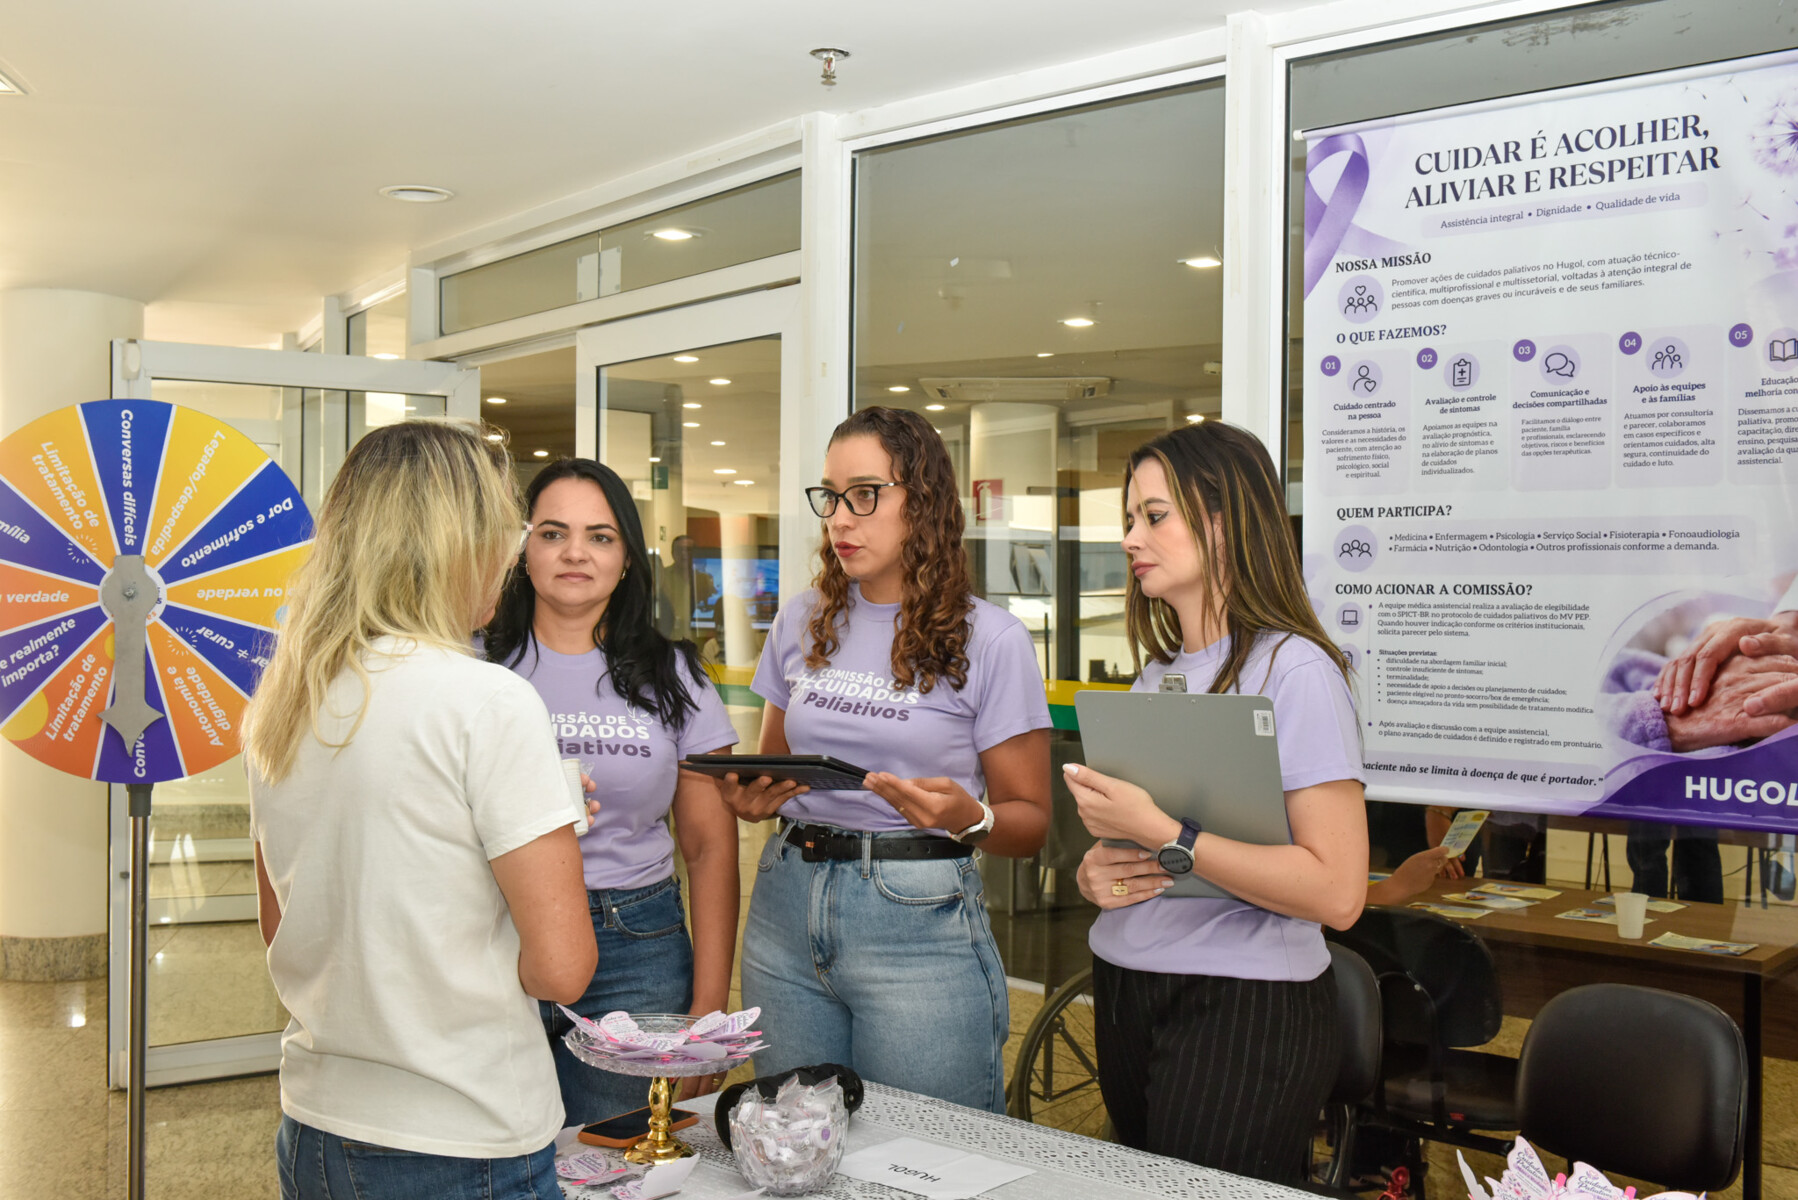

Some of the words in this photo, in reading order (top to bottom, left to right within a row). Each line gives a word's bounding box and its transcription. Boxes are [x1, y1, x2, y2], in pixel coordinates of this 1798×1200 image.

[1415, 141, 1522, 176] CUIDAR
[1531, 130, 1547, 159] É
[1554, 114, 1710, 158] ACOLHER,
[1404, 173, 1516, 208] ALIVIAR
[1525, 170, 1541, 193] E
[1549, 146, 1721, 190] RESPEITAR
[1440, 216, 1488, 228] Assistência
[1490, 211, 1524, 222] integral
[1536, 204, 1582, 217] Dignidade
[1596, 197, 1644, 210] Qualidade
[1645, 195, 1657, 204] de
[1659, 192, 1681, 202] vida
[1336, 259, 1378, 272] NOSSA
[1381, 252, 1432, 267] MISSÃO
[1392, 277, 1429, 286] Promover
[1430, 274, 1453, 283] ações
[1466, 269, 1502, 278] cuidados
[1503, 265, 1541, 276] paliativos
[1556, 260, 1585, 270] Hugol,
[1608, 254, 1642, 264] atuação
[1644, 251, 1680, 260] técnico-
[1391, 288, 1428, 298] científica,
[1429, 281, 1495, 293] multiprofissional
[1502, 274, 1560, 286] multissetorial,
[1562, 271, 1598, 280] voltadas
[1600, 269, 1606, 278] à
[1608, 266, 1642, 276] atenção
[1644, 262, 1678, 273] integral
[1680, 261, 1692, 270] de
[1391, 301, 1421, 310] pessoas
[1440, 296, 1474, 304] doenças
[1475, 293, 1501, 303] graves
[1514, 286, 1557, 296] incuráveis
[1566, 284, 1578, 292] de
[1601, 280, 1646, 289] familiares.
[1336, 333, 1346, 343] O
[1349, 330, 1376, 345] QUE
[1378, 324, 1447, 340] FAZEMOS?
[1624, 339, 1636, 348] 04
[1734, 331, 1748, 340] 05
[1422, 354, 1433, 363] 02
[1518, 346, 1531, 355] 03
[1530, 389, 1584, 398] Comunicação
[1633, 384, 1659, 394] Apoio
[1671, 382, 1706, 391] equipes
[1745, 389, 1783, 397] melhoria
[1364, 400, 1397, 408] centrado
[1425, 397, 1460, 405] Avaliação
[1466, 394, 1497, 402] controle
[1546, 398, 1608, 407] compartilhadas
[1659, 394, 1696, 402] famílias
[121, 409, 134, 488] Conversas
[32, 454, 83, 529] tratamento
[41, 442, 86, 507] Limitação
[84, 510, 99, 527] de
[151, 430, 226, 556] Legado/despedida
[268, 497, 294, 519] Dor
[1337, 507, 1374, 520] QUEM
[1378, 505, 1452, 517] PARTICIPA?
[123, 491, 137, 546] difíceis
[256, 514, 266, 524] e
[181, 520, 254, 568] sofrimento
[1435, 533, 1488, 541] Enfermagem
[1496, 532, 1536, 541] Psicologia
[1543, 531, 1575, 540] Serviço
[1576, 531, 1602, 539] Social
[1609, 530, 1660, 539] Fisioterapia
[1668, 530, 1740, 539] Fonoaudiologia
[1394, 544, 1428, 552] Farmácia
[1435, 544, 1472, 552] Nutrição
[1478, 543, 1529, 552] Odontologia
[1536, 543, 1566, 551] Outros
[1567, 543, 1622, 552] profissionais
[1622, 542, 1665, 550] conforme
[1674, 542, 1721, 550] demanda.
[7, 590, 69, 603] verdade
[196, 588, 259, 601] verdade
[264, 588, 283, 596] ou
[1335, 584, 1373, 594] COMO
[1375, 584, 1435, 594] ACIONAR
[1439, 584, 1449, 594] A
[1453, 582, 1533, 595] COMISSÃO?
[9, 618, 76, 665] realmente
[196, 626, 234, 650] curar
[1, 644, 60, 688] importa?
[167, 666, 177, 674] e
[820, 668, 884, 687] COMISSÃO
[45, 674, 85, 741] Limitação
[82, 654, 96, 672] de
[63, 667, 107, 742] tratamento
[186, 666, 231, 731] dignidade
[803, 692, 910, 721] Paliativos
[174, 677, 224, 747] Autonomia
[551, 712, 601, 724] ISSÃO
[606, 715, 627, 725] DE
[552, 723, 650, 739] IDADOS
[557, 738, 651, 758] iativos
[1399, 764, 1417, 772] não
[1431, 766, 1460, 775] limita
[1461, 768, 1468, 776] à
[1470, 768, 1505, 780] doença
[1506, 771, 1519, 780] de
[1520, 774, 1538, 782] que
[1540, 773, 1547, 782] é
[1686, 776, 1798, 806] HUGOL
[888, 1164, 941, 1182] HUGOL
